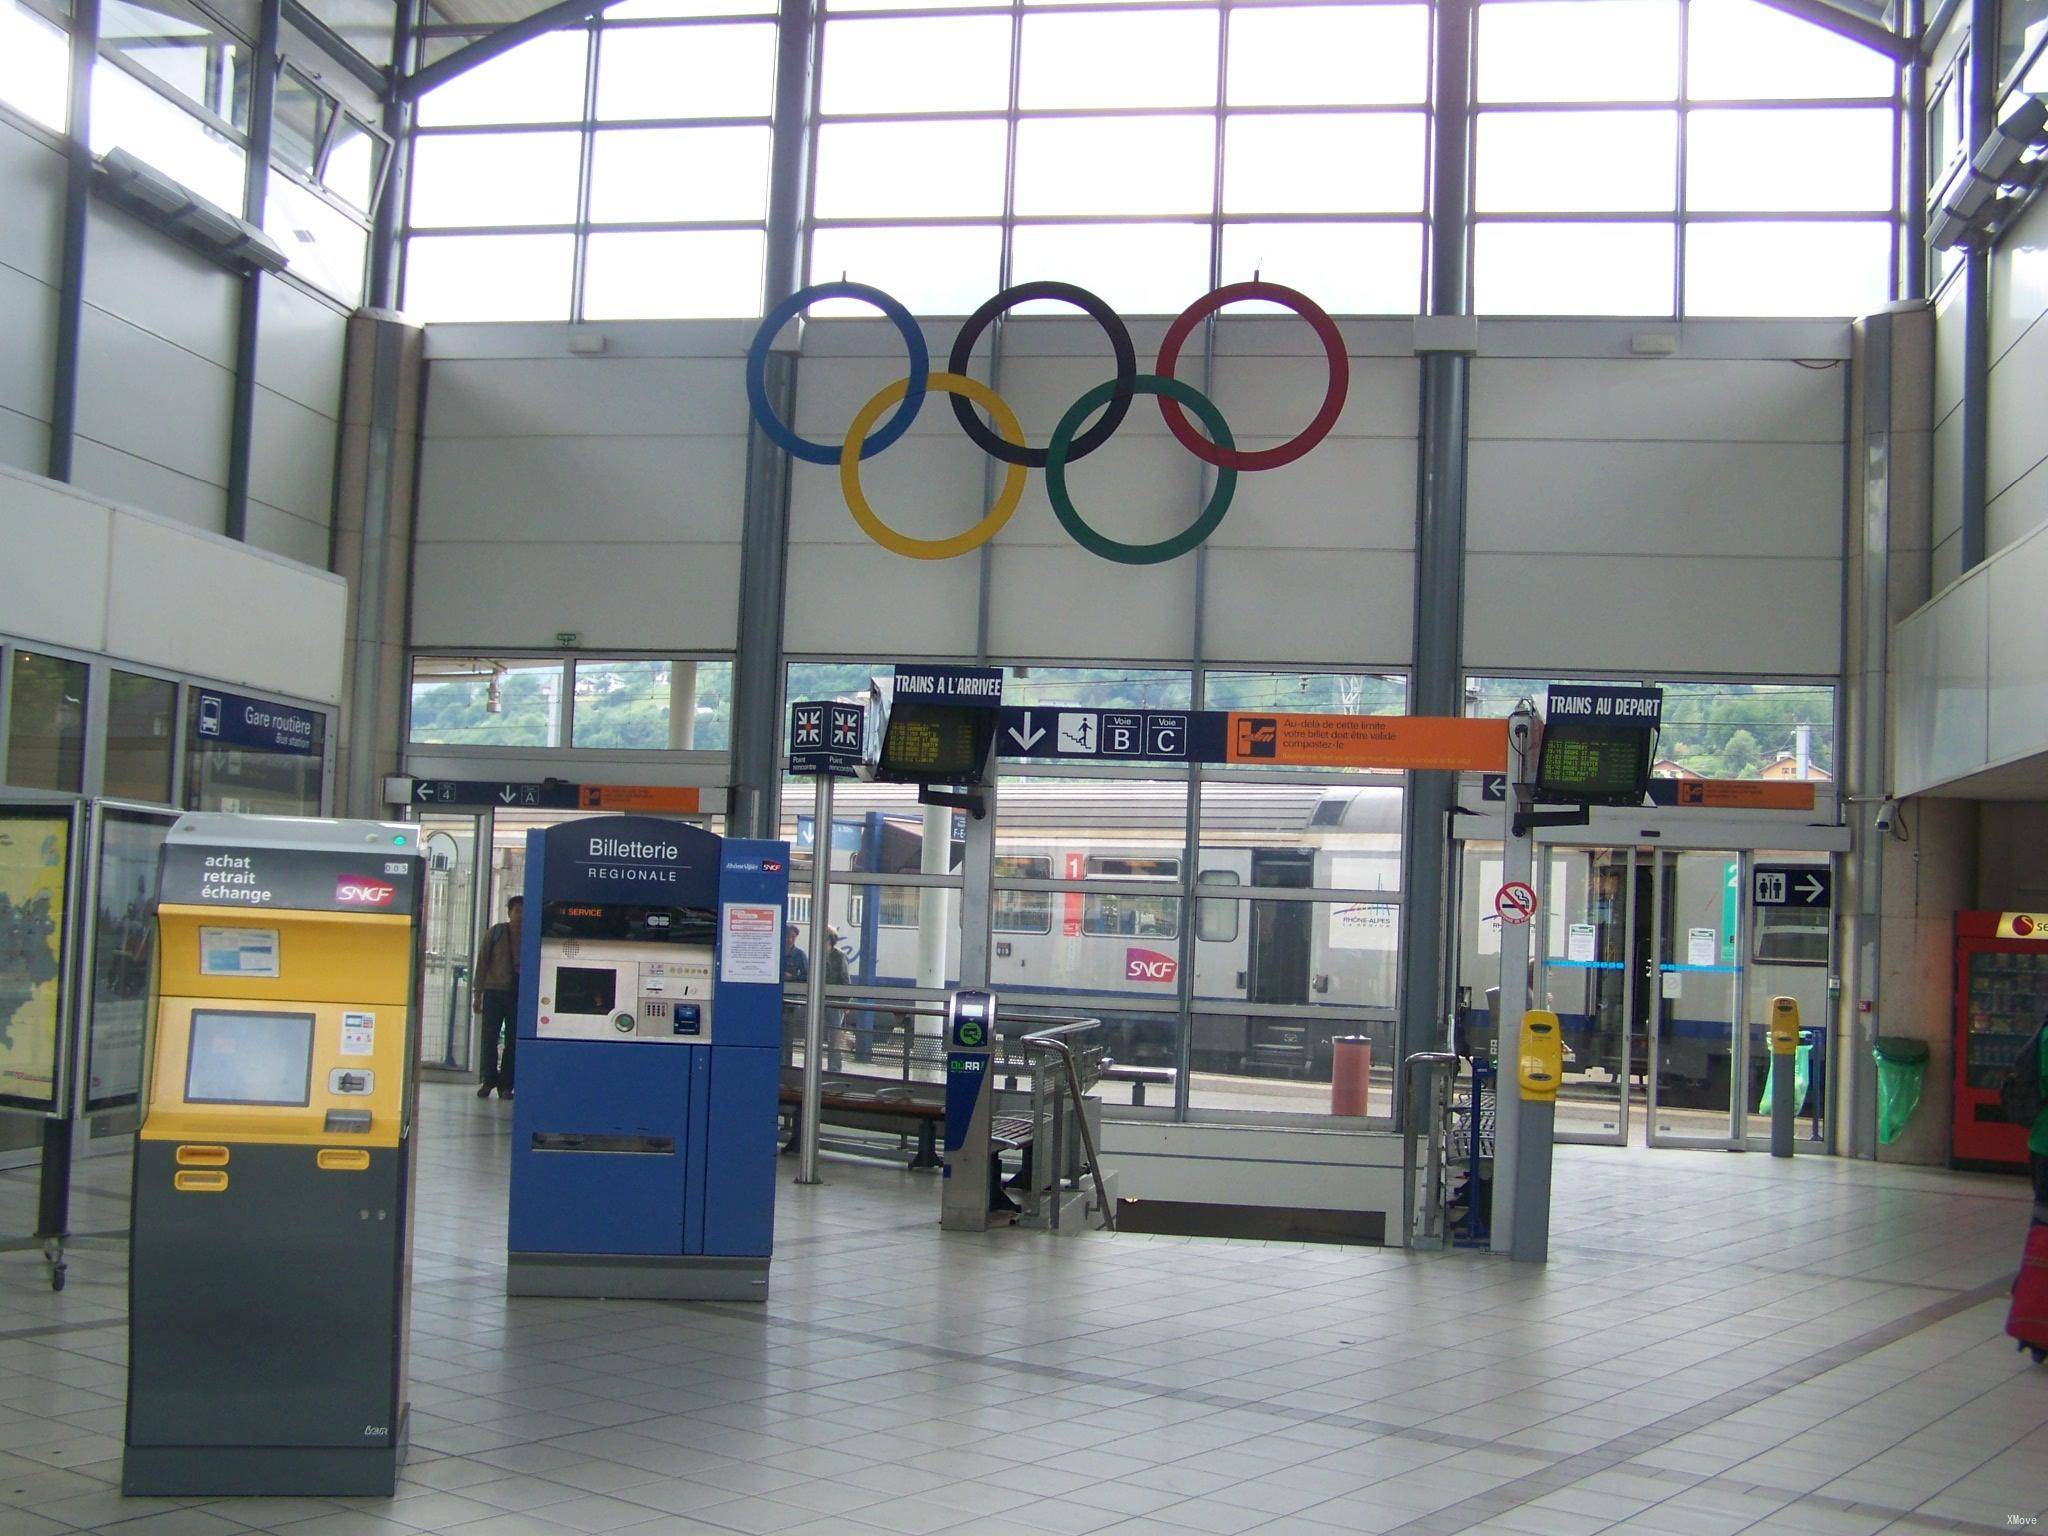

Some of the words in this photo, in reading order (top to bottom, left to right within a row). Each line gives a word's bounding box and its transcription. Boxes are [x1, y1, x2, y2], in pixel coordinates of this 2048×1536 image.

[896, 675, 934, 693] TRAINS
[937, 676, 945, 694] A
[948, 677, 1001, 696] L'ARRIVEE
[1550, 696, 1592, 714] TRAINS
[1596, 697, 1611, 716] AU
[1615, 698, 1660, 717] DEPART
[245, 706, 270, 727] Gare
[272, 714, 311, 736] routière
[1114, 717, 1131, 726] Voie
[1158, 718, 1176, 727] Voie
[1322, 720, 1334, 729] de
[289, 736, 310, 748] station
[1114, 729, 1130, 750] B
[1157, 730, 1175, 752] C
[1370, 731, 1396, 741] valide
[442, 790, 450, 799] 4
[525, 792, 535, 803] A
[589, 838, 678, 860] Billetterie
[205, 855, 251, 869] achat
[1069, 858, 1079, 879] 1
[203, 871, 256, 886] retrait
[588, 867, 677, 882] REGIONALE
[201, 885, 272, 903] échange
[337, 887, 393, 905] SNCF
[568, 908, 602, 917] SERVICE
[1343, 916, 1390, 924] RHÔNE-ALPES
[1128, 960, 1175, 978] SNCF
